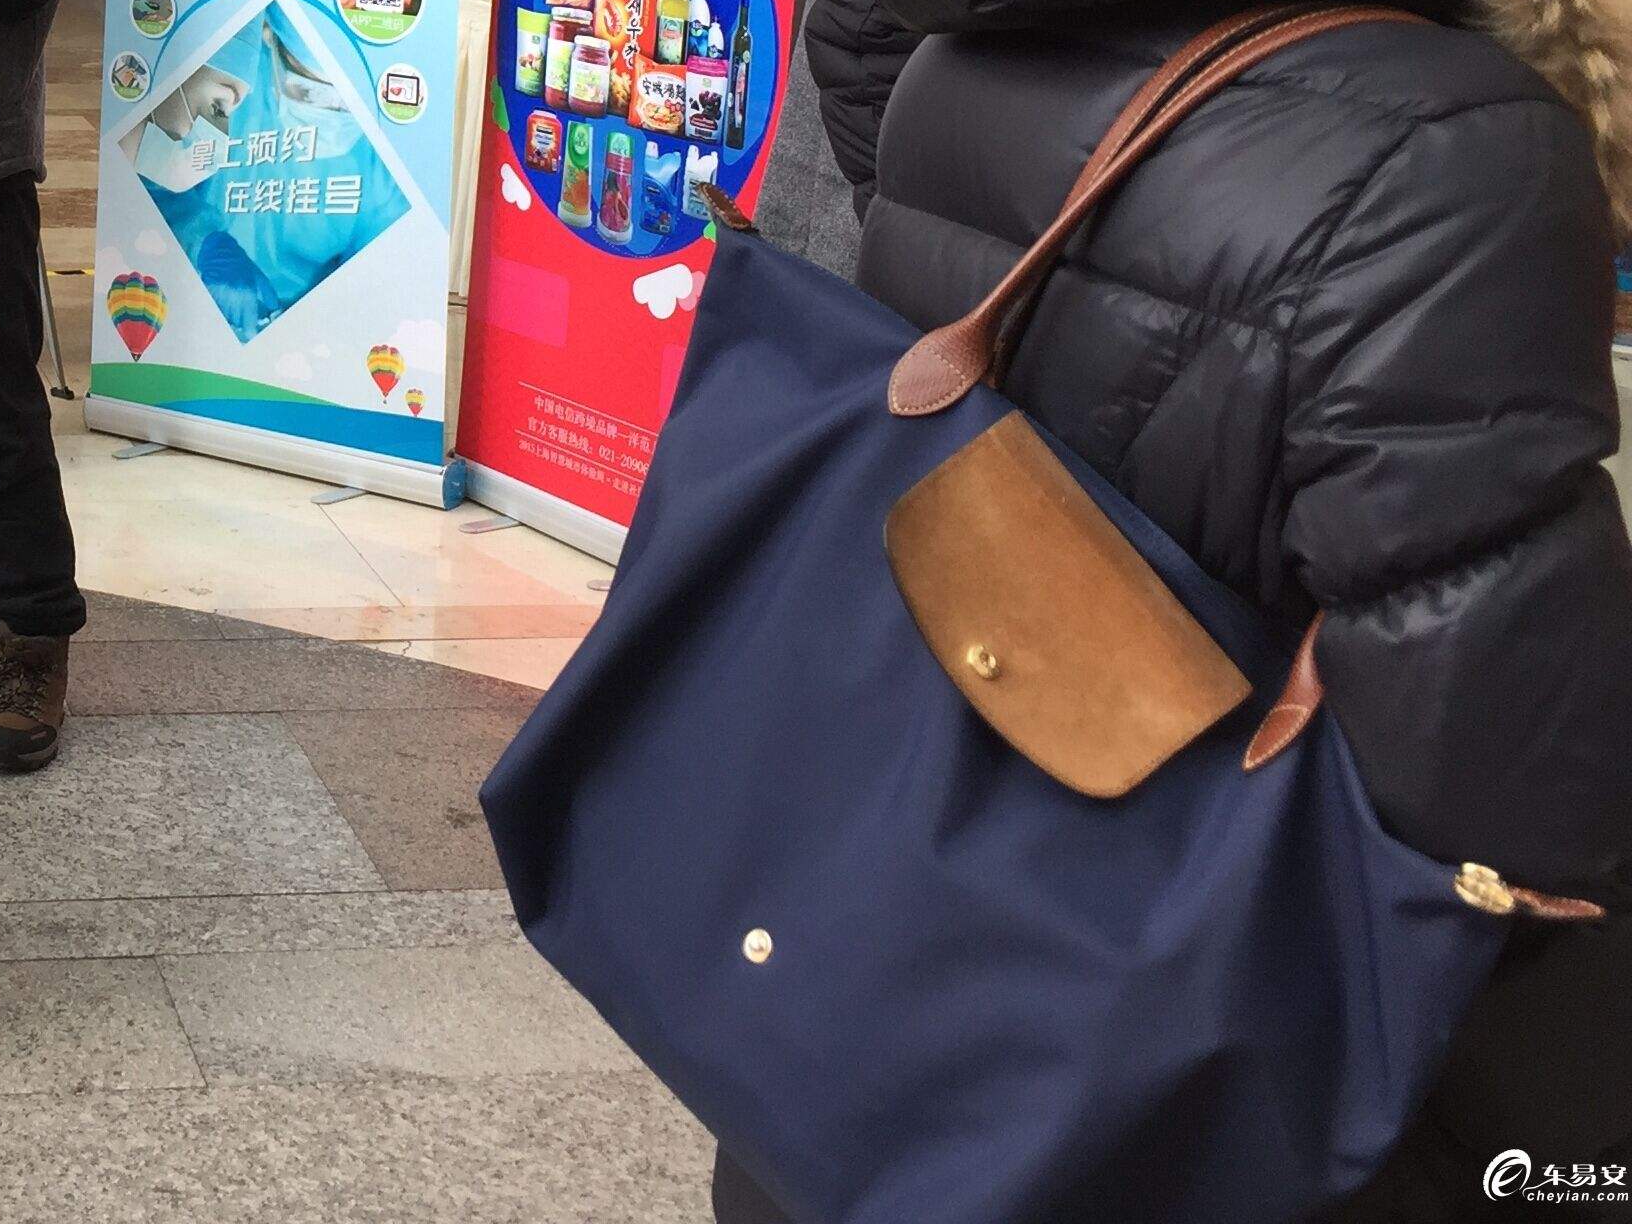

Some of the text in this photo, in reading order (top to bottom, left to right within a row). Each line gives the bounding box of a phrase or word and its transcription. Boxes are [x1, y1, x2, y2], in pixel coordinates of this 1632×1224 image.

[190, 124, 319, 171] 掌上预约
[223, 173, 363, 215] 在线挂号
